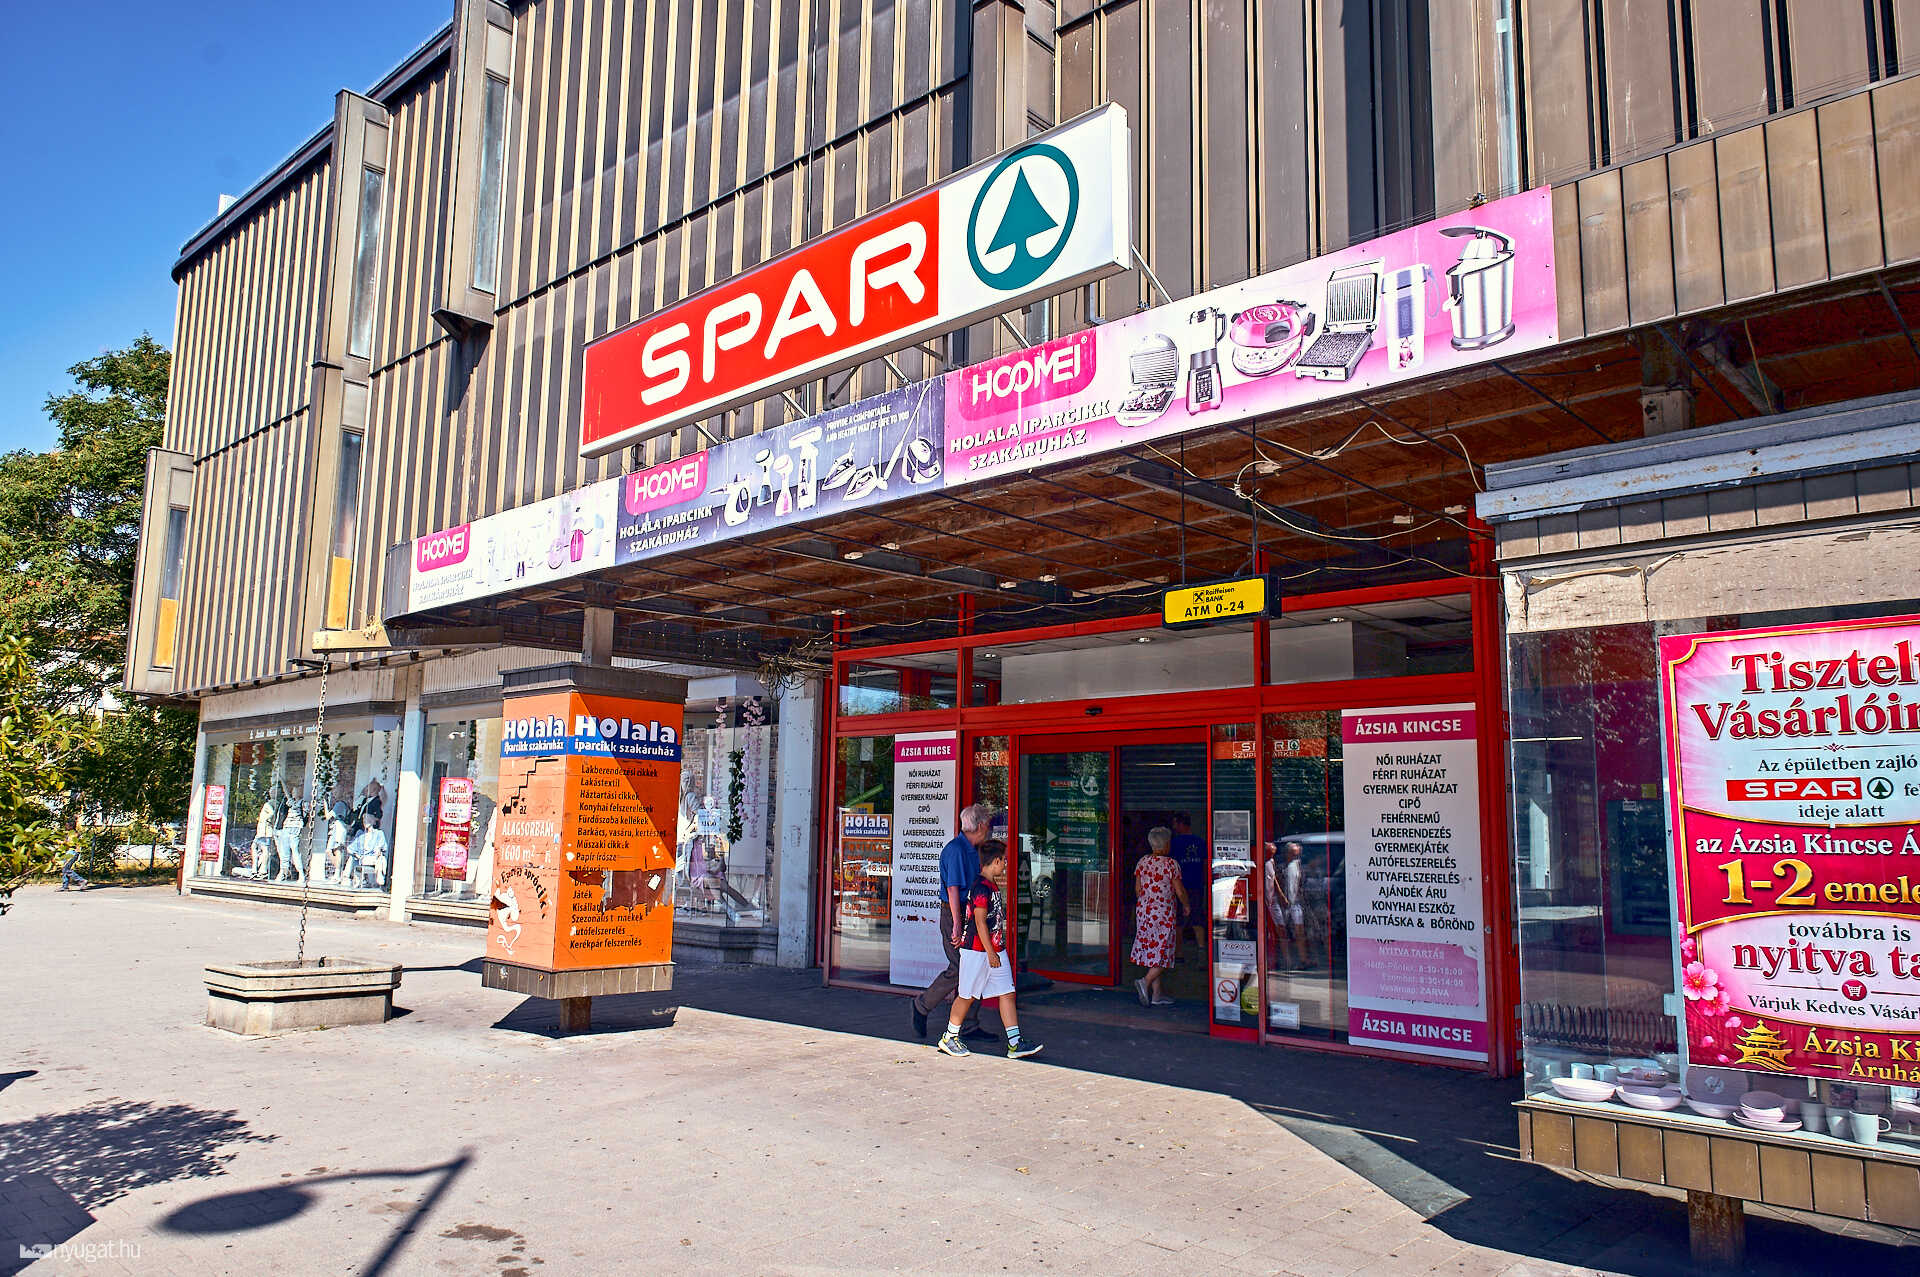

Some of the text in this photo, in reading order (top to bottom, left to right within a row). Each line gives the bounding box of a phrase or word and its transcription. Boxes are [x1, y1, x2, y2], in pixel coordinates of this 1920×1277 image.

[640, 221, 927, 406] SPAR
[972, 343, 1081, 406] HOOMEI
[950, 400, 1110, 453] HOLALA IPARCIKK
[968, 428, 1087, 470] SZAKÁRUHÁZ
[634, 462, 699, 504] HOOMEI
[619, 505, 713, 539] HOLALA IPARCIKK
[629, 525, 699, 553] SZAKÁRUHÁZ
[421, 532, 465, 563] HOOMEI
[1205, 587, 1235, 596] Raiffeisen
[1206, 595, 1224, 603] BANK
[1184, 600, 1245, 617] ATM 0-24
[1731, 640, 1920, 694] Tisztel
[504, 714, 566, 739] Holala
[574, 714, 677, 744] Holala
[1355, 718, 1462, 736] ÁZSIA KINCSE
[504, 738, 564, 755] iparcikk szakáruház
[574, 738, 675, 756] iparcikk szakáruház
[900, 745, 951, 757] ÁZSIA KINCSE
[1376, 752, 1442, 765] NŐI RUHÁZAT
[1757, 755, 1918, 774] Az épületben zajló
[581, 764, 658, 777] Lakberendezési cikkek
[918, 768, 941, 777] RUHÁZAT
[1372, 767, 1447, 780] FÉRFI RUHÁZAT
[580, 777, 620, 787] Lakástextil
[906, 780, 944, 790] FÉRFI RUHÁZAT
[1362, 782, 1458, 794] GYERMEK RUHÁZAT
[1745, 780, 1920, 798] SPAR fe
[580, 789, 640, 800] Háztartási cikkek
[901, 792, 949, 801] GYERMEK RUHÁZAT
[579, 802, 608, 813] Konyhai
[1398, 796, 1421, 809] CIPŐ
[520, 805, 527, 815] az
[1799, 804, 1885, 820] ideje alatt
[578, 814, 649, 825] Fürdőszoba kellékek
[845, 815, 889, 828] Holala
[1381, 811, 1440, 824] FEHÉRNEMŰ
[502, 821, 554, 837] ALAGSORBAN!
[902, 829, 945, 837] LAKBERENDEZÉS
[1371, 826, 1452, 839] LAKBERENDEZÉS
[903, 839, 944, 849] GYERMEKJÁTÉK
[1374, 841, 1449, 855] GYERMEKJÁTÉK
[1695, 838, 1722, 853] az
[1728, 828, 1797, 854] Ázsia
[1802, 833, 1893, 855] Kincse
[596, 852, 617, 862] írósze
[900, 852, 941, 861] AUTÓFELSZEREL
[1368, 855, 1457, 869] AUTÓFELSZERELÉS
[905, 876, 929, 885] AJÁNDÉK
[1366, 871, 1460, 884] KUTYAFELSZERELÉS
[1718, 858, 1816, 907] 1-2
[572, 889, 593, 899] Játék
[924, 888, 940, 897] ESZKÖ
[1379, 884, 1447, 899] AJÁNDÉK ÁRU
[894, 899, 925, 908] DIVATTÁSKA
[929, 900, 942, 909] BŐR
[1371, 900, 1456, 915] KONYHAI ESZKÖZ
[1355, 914, 1475, 931] DIVATTÁSKA & BŐRÖND
[570, 926, 626, 936] utófelszerelés
[1788, 922, 1911, 941] továbbra is
[569, 937, 642, 950] Kerékpár felszerelés
[1732, 938, 1878, 979] nyitva
[1748, 994, 1920, 1020] Várjuk Kedves Vásár
[1361, 1012, 1473, 1043] ÁZSIA KINCSE
[1803, 1026, 1881, 1059] Ázsia
